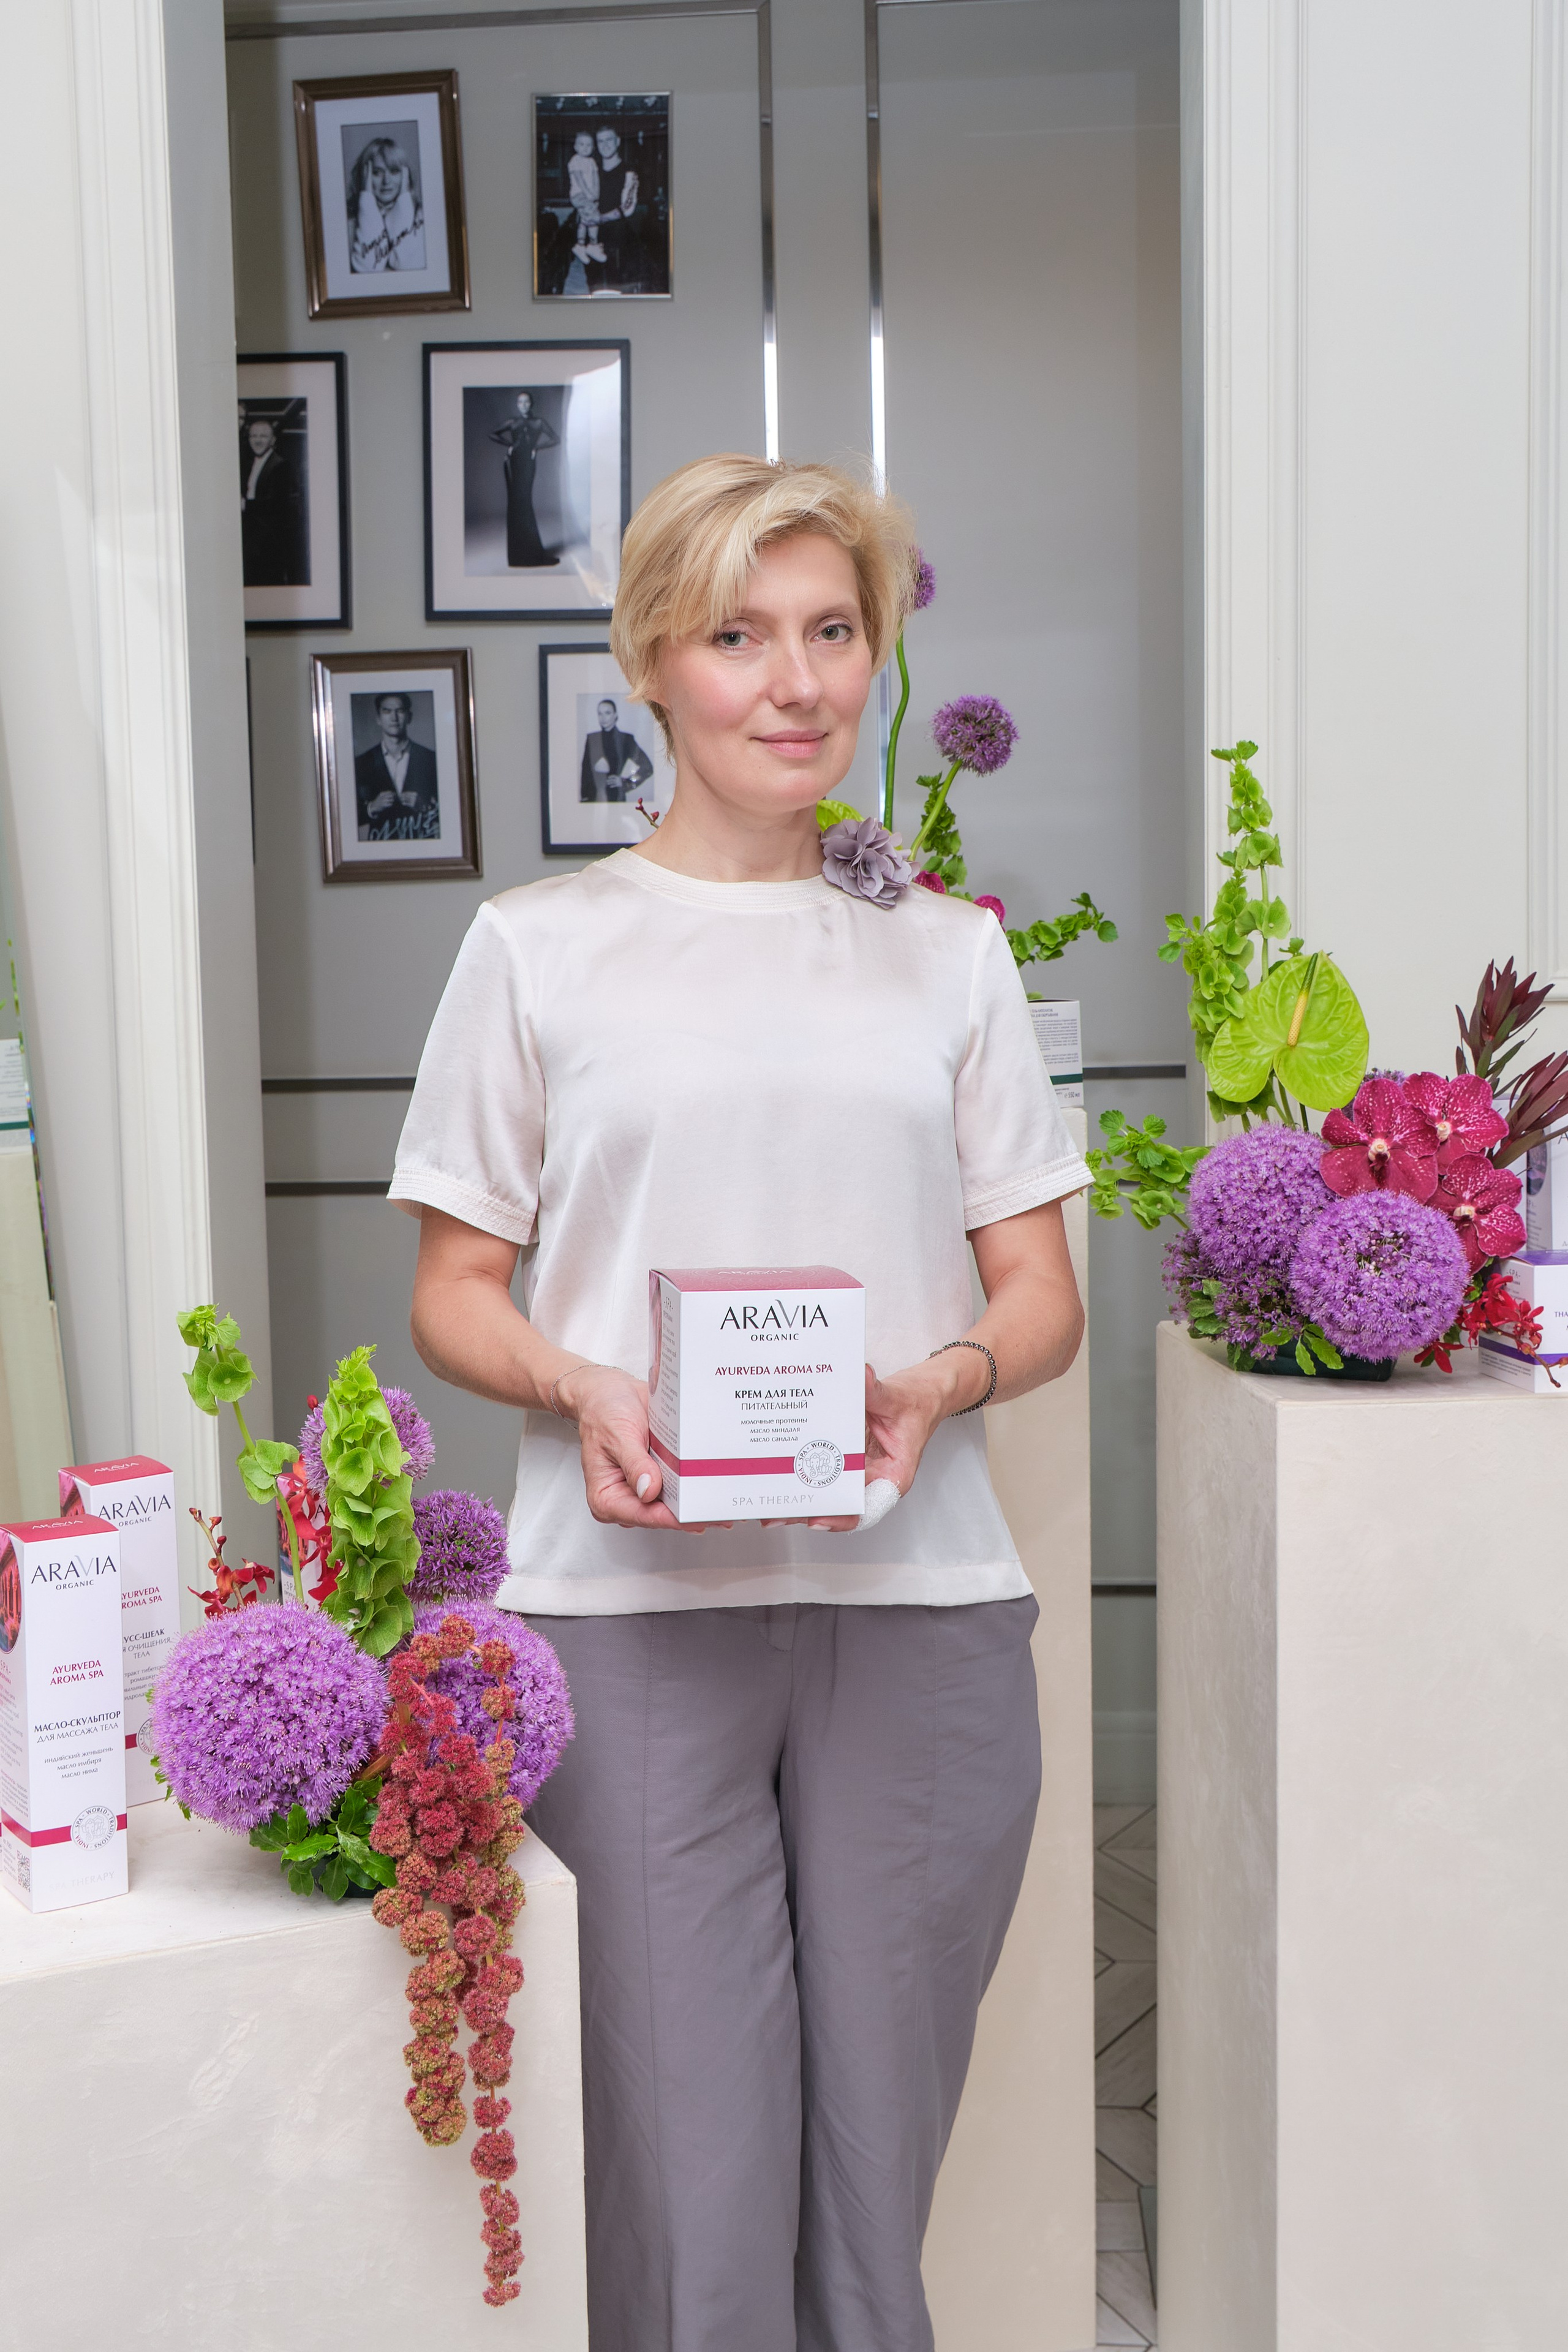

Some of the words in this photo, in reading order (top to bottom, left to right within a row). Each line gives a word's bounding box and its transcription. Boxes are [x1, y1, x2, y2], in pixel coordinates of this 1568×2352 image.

[720, 1299, 829, 1330] ARAVIA
[750, 1333, 799, 1342] ORGANIC
[715, 1366, 770, 1376] AYURVEDA
[774, 1365, 813, 1374] AROMA
[815, 1363, 833, 1373] SPA
[734, 1390, 762, 1399] КРЕМ
[764, 1389, 786, 1400] ДЛЯ
[789, 1388, 814, 1397] ТЕЛА
[741, 1400, 808, 1411] ПИТАТЕЛЬНЫЙ
[811, 1442, 834, 1451] WORLD
[798, 1450, 807, 1461] SPA
[798, 1468, 812, 1485] INDIA
[818, 1455, 841, 1487] TRADITIONS
[99, 1494, 171, 1520] ARAVIA
[732, 1497, 753, 1506] SPA
[759, 1494, 815, 1505] THERAPY
[118, 1516, 152, 1527] ORGANIC
[31, 1555, 116, 1585] ARAVIA
[56, 1580, 94, 1590] ORGANIC
[121, 1586, 160, 1600] YURVEDA
[121, 1599, 147, 1610] ROMA
[149, 1595, 162, 1604] SPA
[123, 1628, 165, 1643] УСС-ШЕЛК
[128, 1637, 170, 1652] ОЧИЩЕНИЯ
[133, 1651, 150, 1659] ТЕЛА
[52, 1659, 101, 1675] AYURVEDA
[50, 1673, 86, 1686] AROMA
[88, 1670, 104, 1679] SPA
[34, 1711, 121, 1733] МАСЛО-СКУЛЬПТОР
[37, 1733, 55, 1743] ДЛЯ
[56, 1727, 98, 1740] МАССАЖА
[100, 1722, 119, 1732] ТЕЛА
[44, 1752, 80, 1763] индийский
[81, 1747, 113, 1757] женьшень
[78, 1757, 102, 1767] имбиря
[82, 1767, 98, 1776] нима
[94, 1816, 115, 1849] TRADITIONS
[75, 1834, 89, 1849] INDIA
[71, 1871, 115, 1887] THERAPY
